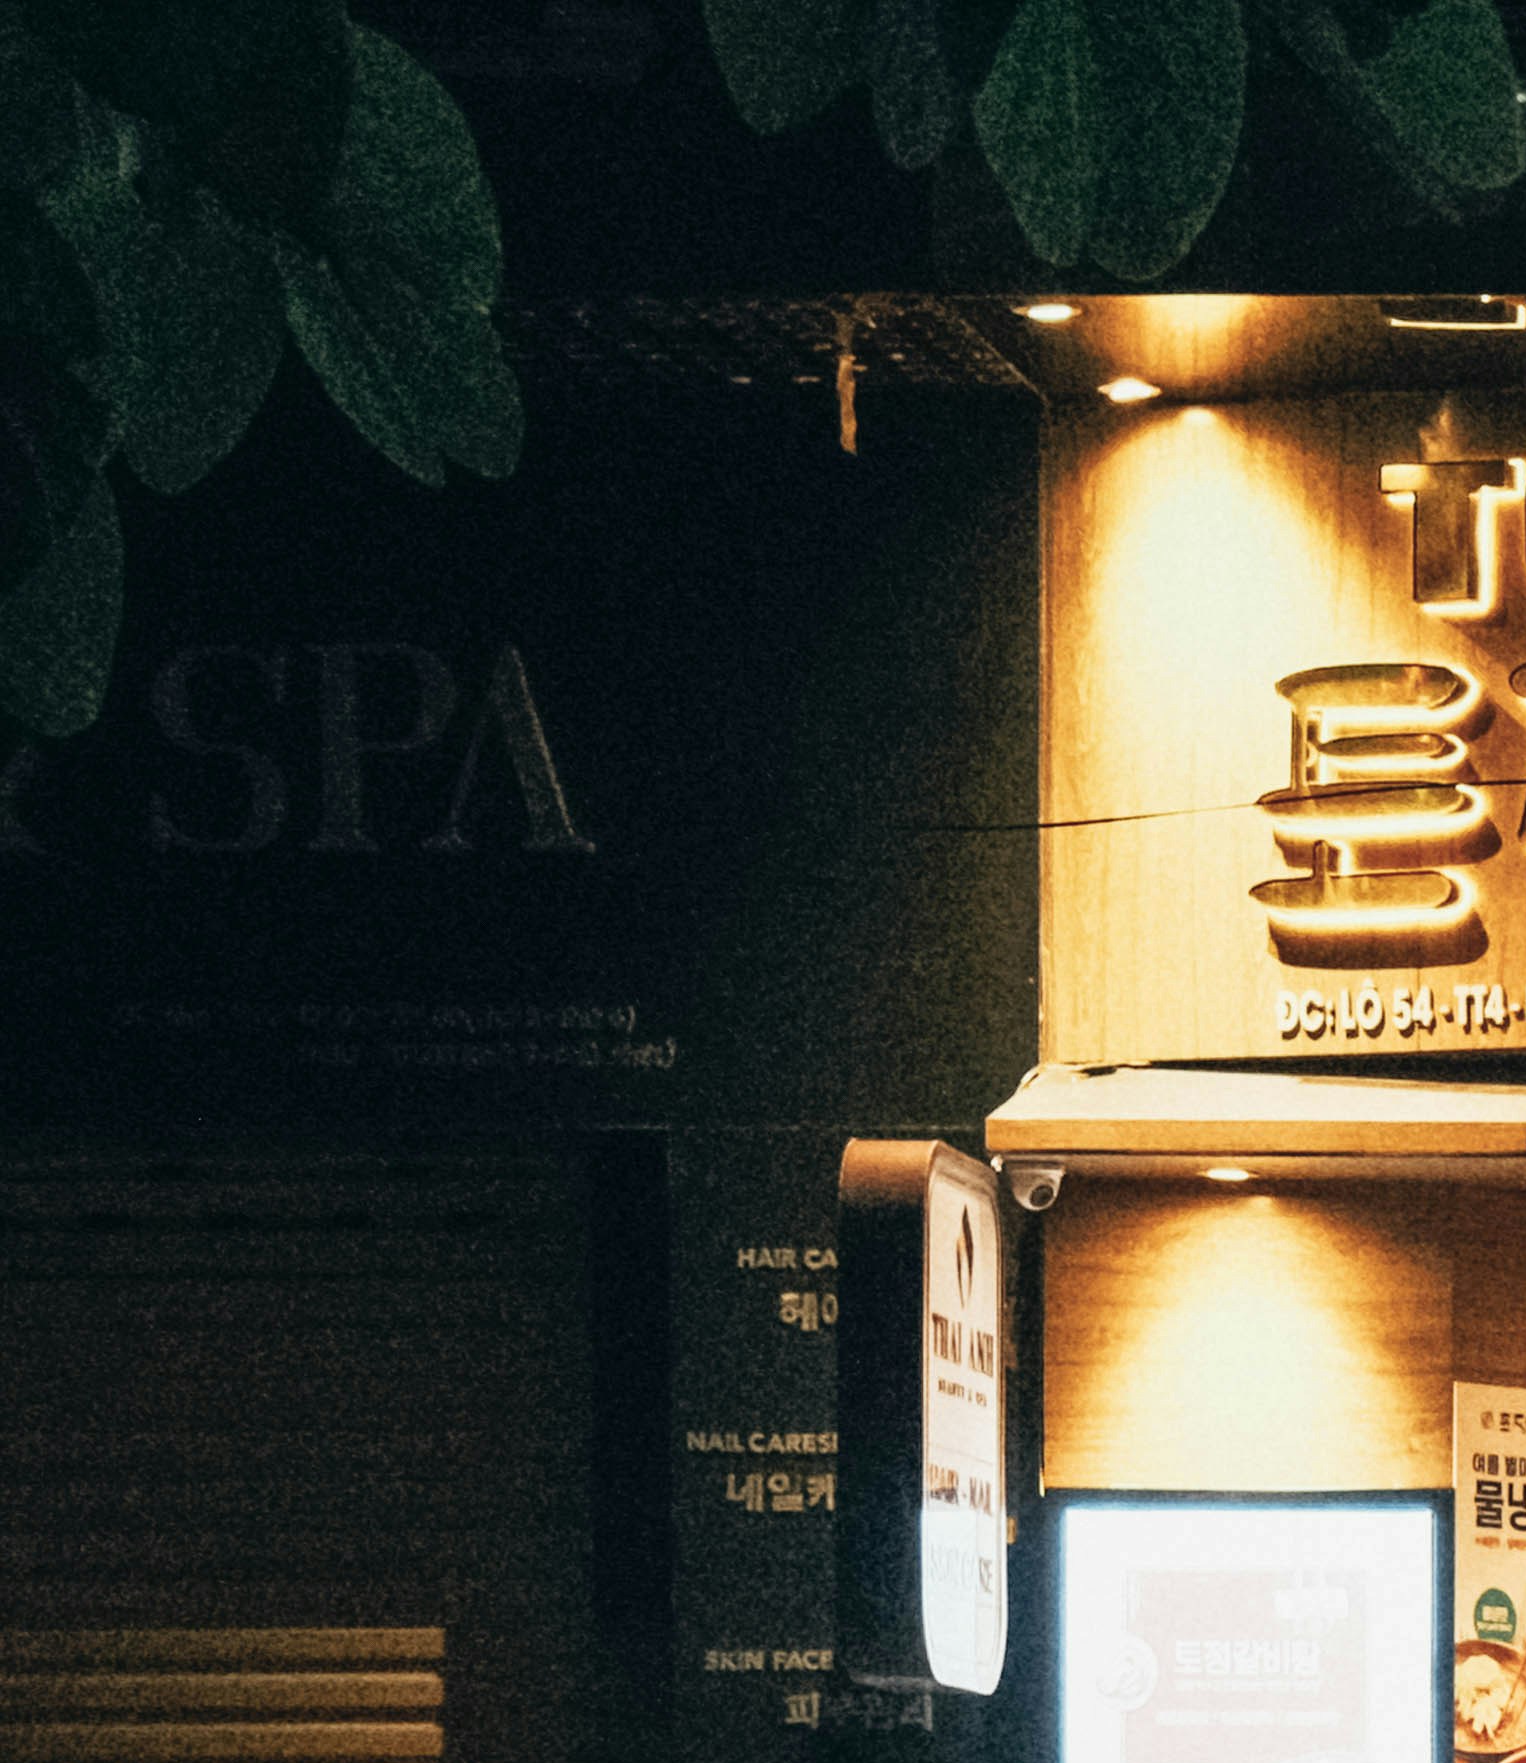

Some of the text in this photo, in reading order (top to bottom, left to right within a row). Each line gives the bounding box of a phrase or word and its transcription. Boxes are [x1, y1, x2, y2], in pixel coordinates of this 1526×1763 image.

[148, 642, 598, 852] SPA
[1340, 977, 1383, 1030] LÔ
[1392, 986, 1434, 1027] 54
[736, 1247, 798, 1270] HAIR
[968, 1327, 994, 1378] ANH
[685, 1430, 744, 1453] NAIL
[704, 1648, 835, 1672] SKIN FACE
